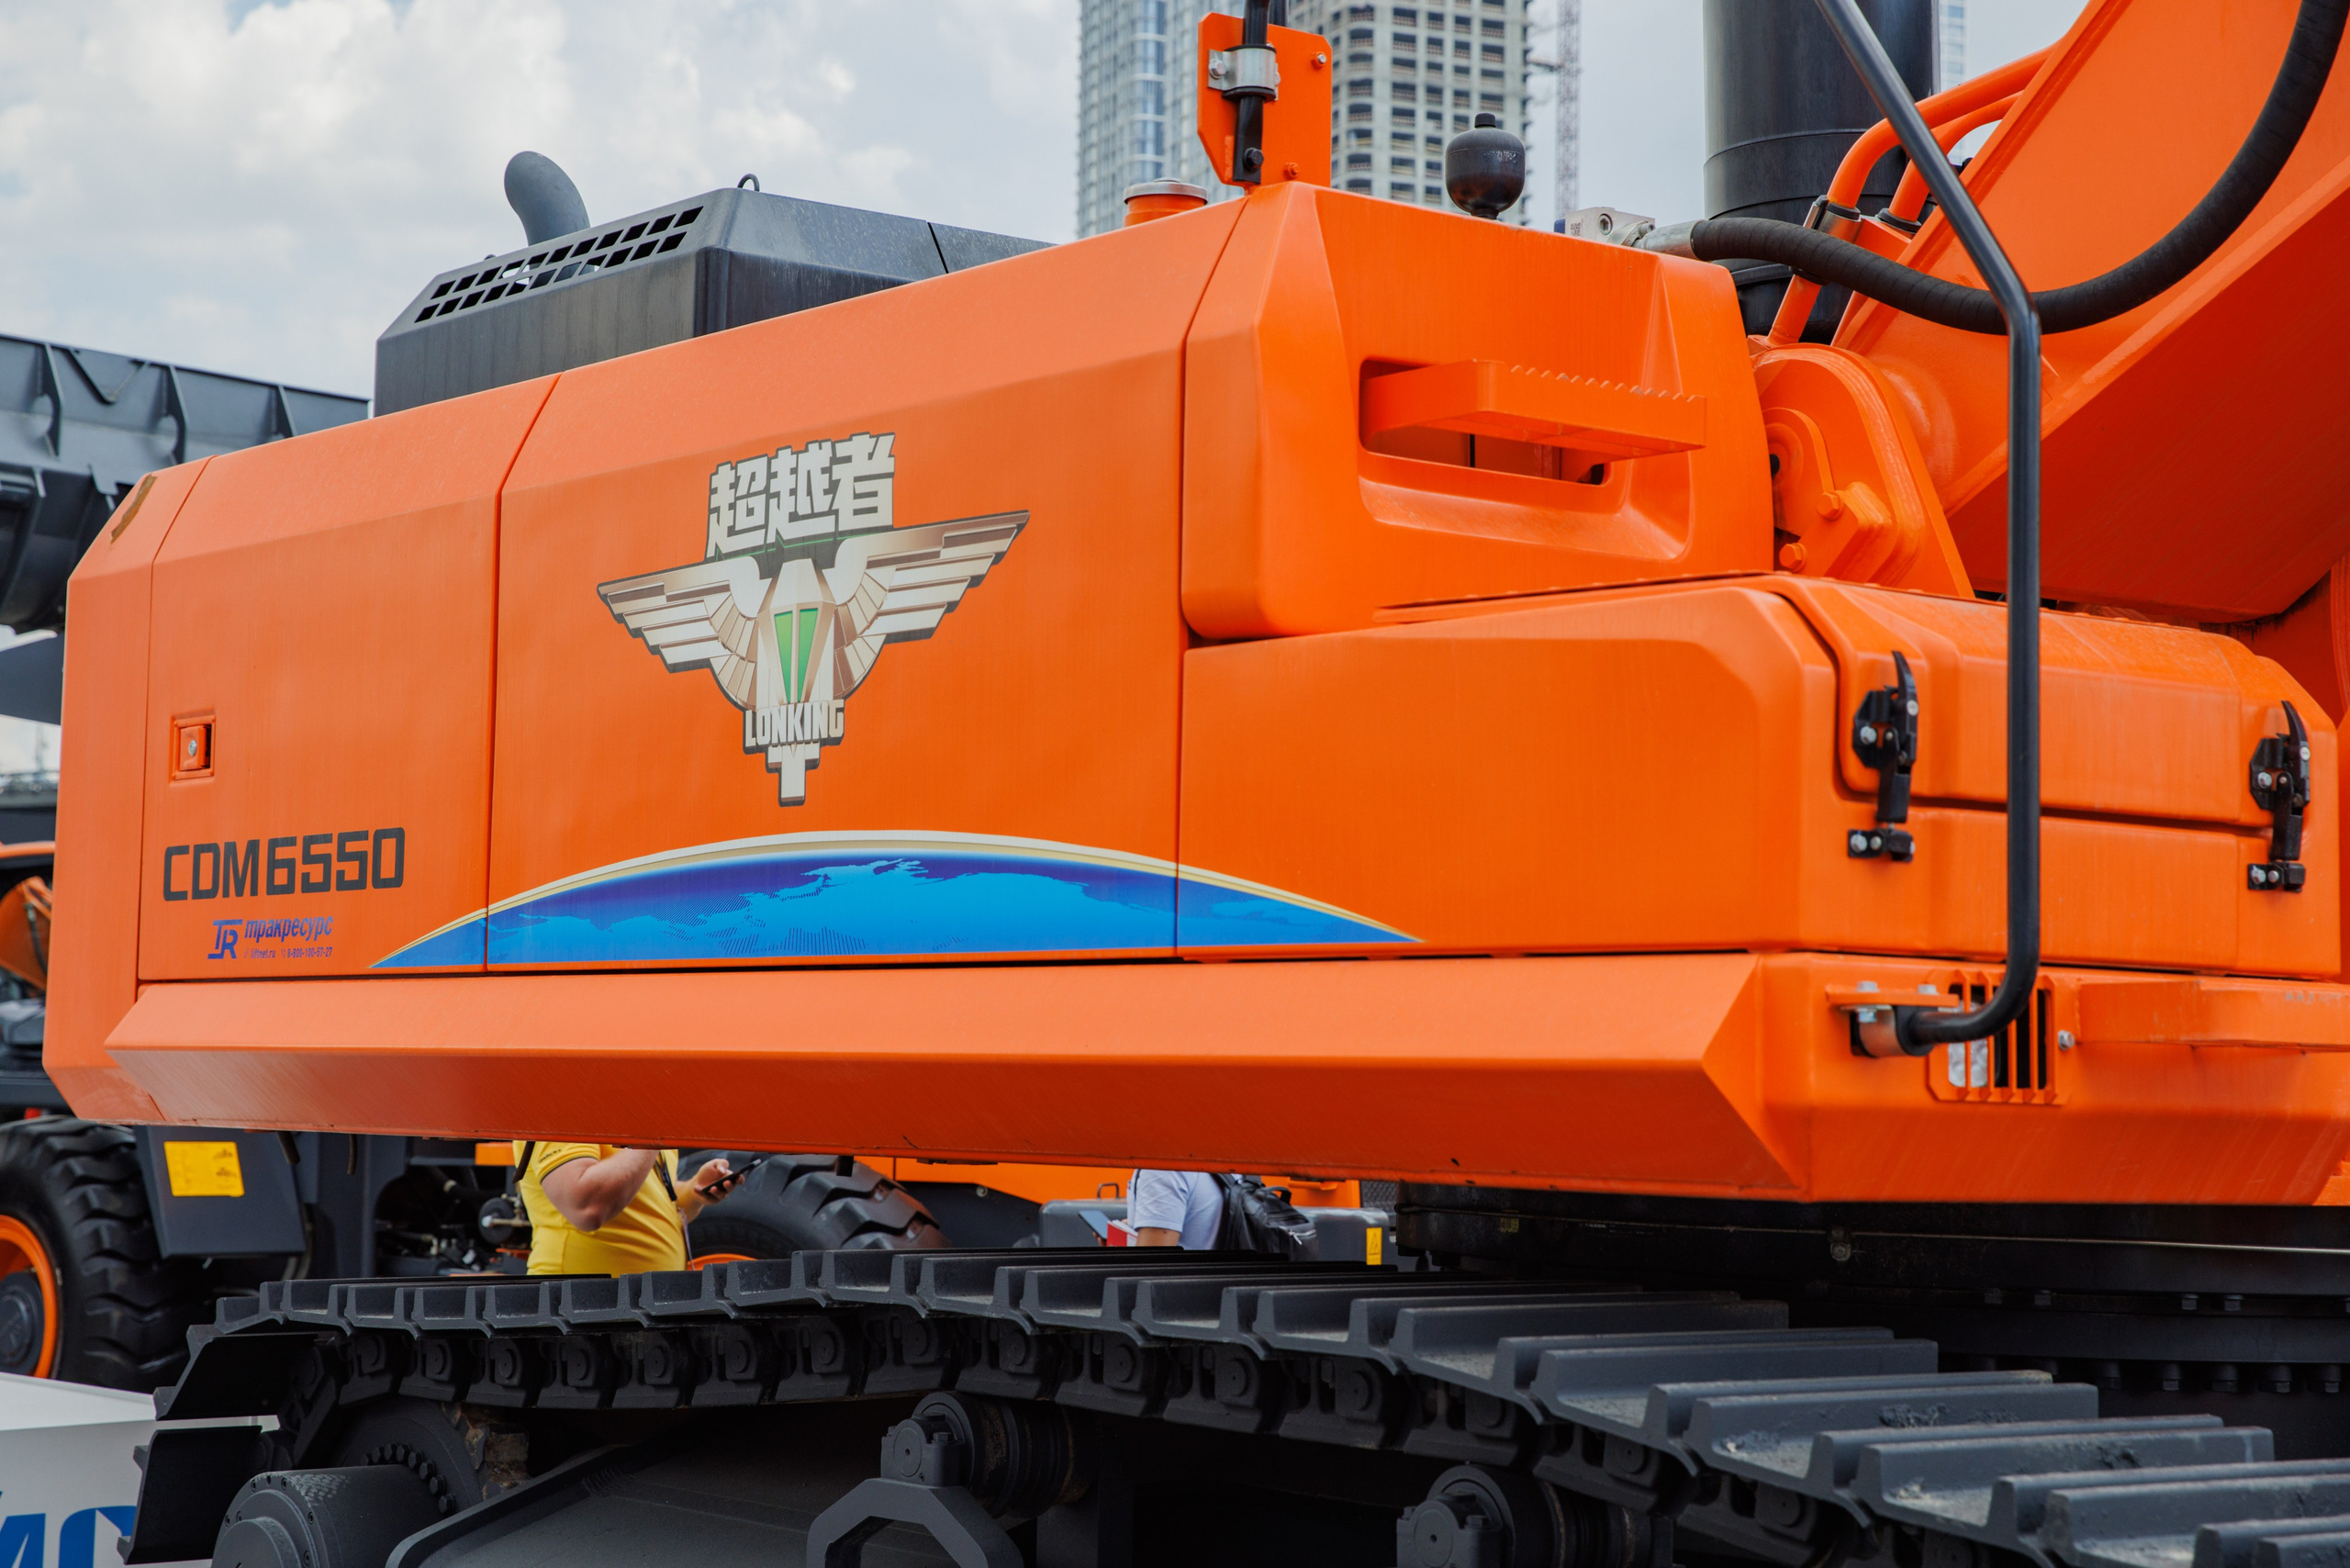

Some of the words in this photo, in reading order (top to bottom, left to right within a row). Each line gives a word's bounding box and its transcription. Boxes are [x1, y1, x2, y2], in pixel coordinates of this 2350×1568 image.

[708, 431, 896, 559] 超越者
[744, 699, 845, 749] LONKING
[163, 826, 406, 902] CDM6550
[244, 916, 334, 943] тракресурс
